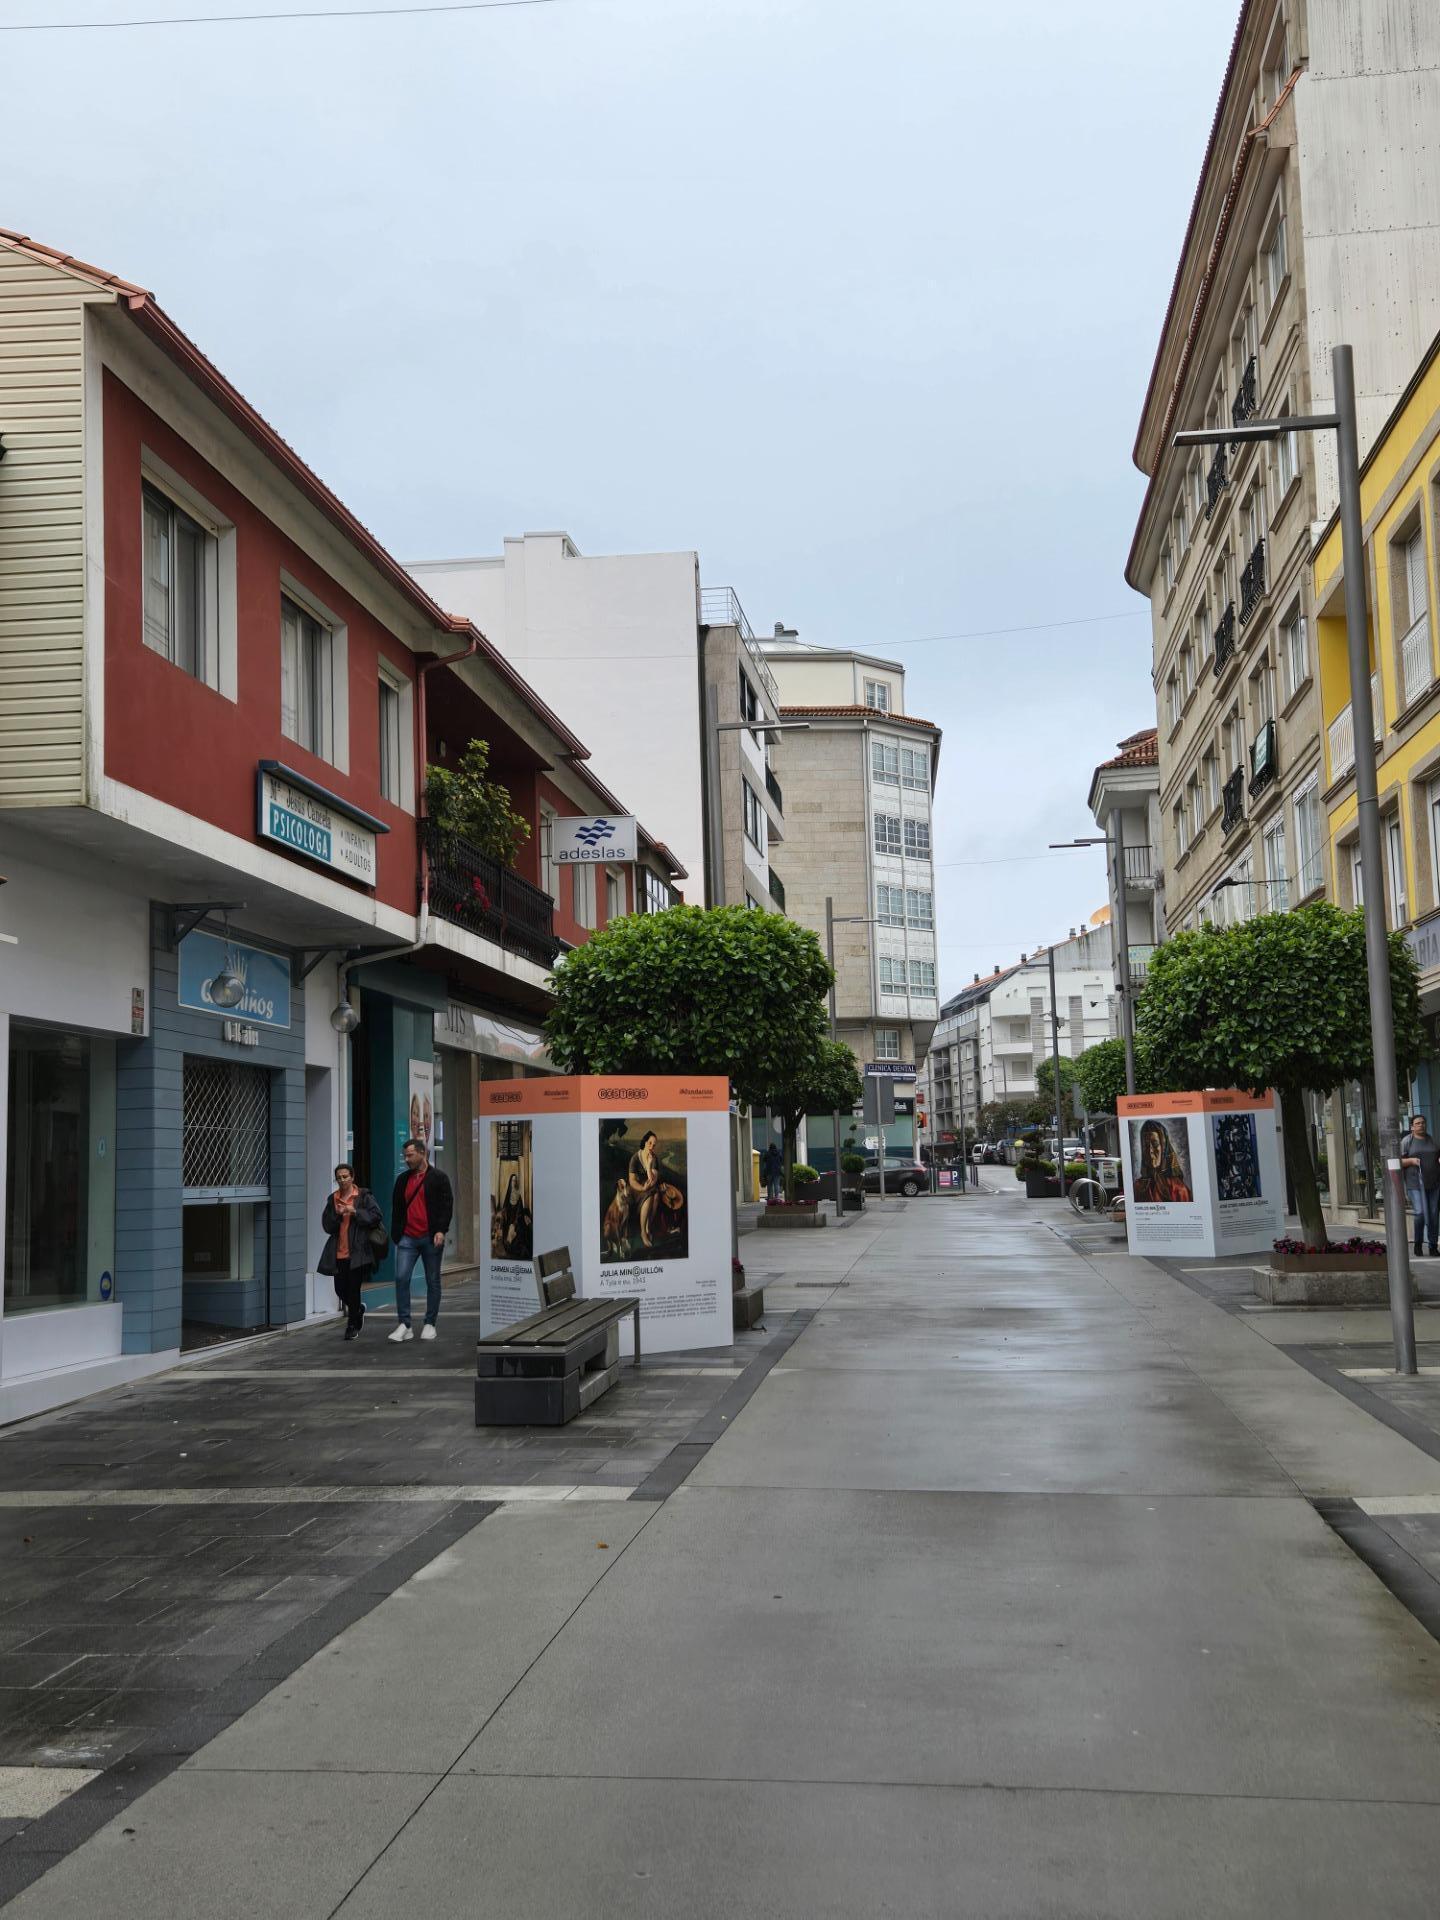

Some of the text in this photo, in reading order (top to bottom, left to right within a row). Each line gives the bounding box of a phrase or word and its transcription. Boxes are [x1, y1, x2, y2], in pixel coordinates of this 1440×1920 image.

[273, 809, 328, 858] PSICOLOGA
[559, 846, 626, 860] adeslas
[345, 849, 371, 873] ADULTOS
[952, 1170, 958, 1181] P
[600, 1265, 664, 1278] JULIA MINGUILLÓN
